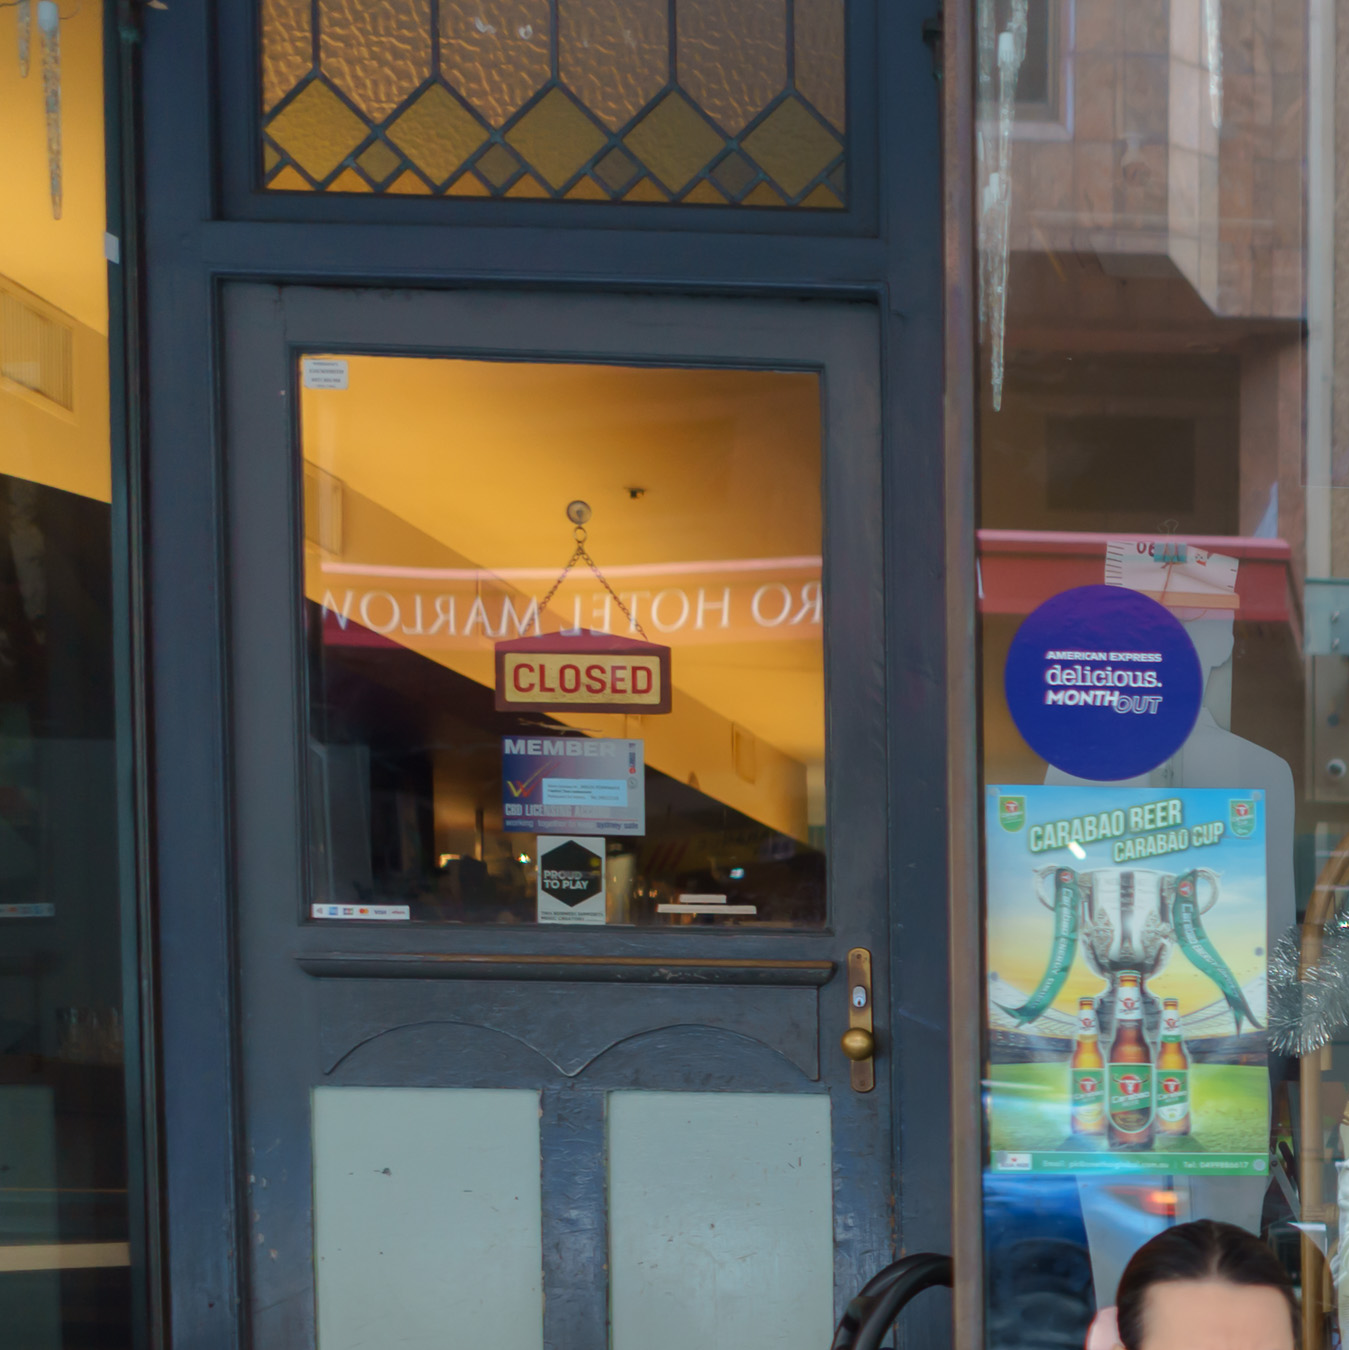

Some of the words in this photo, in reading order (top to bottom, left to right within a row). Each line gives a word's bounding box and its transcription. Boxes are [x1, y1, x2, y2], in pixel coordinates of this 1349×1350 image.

[1045, 650, 1108, 661] AMERICAN
[1108, 651, 1163, 663] EXPRESS
[512, 662, 654, 696] CLOSED
[1044, 664, 1163, 688] delicious.
[504, 738, 617, 757] MEMBER
[1029, 808, 1125, 853] CARABAO
[1130, 798, 1182, 831] BEER
[1112, 828, 1189, 863] CARABAO
[1191, 821, 1225, 847] CUP
[543, 870, 583, 880] PROUD
[543, 880, 560, 889] TO
[562, 880, 589, 890] PLAY
